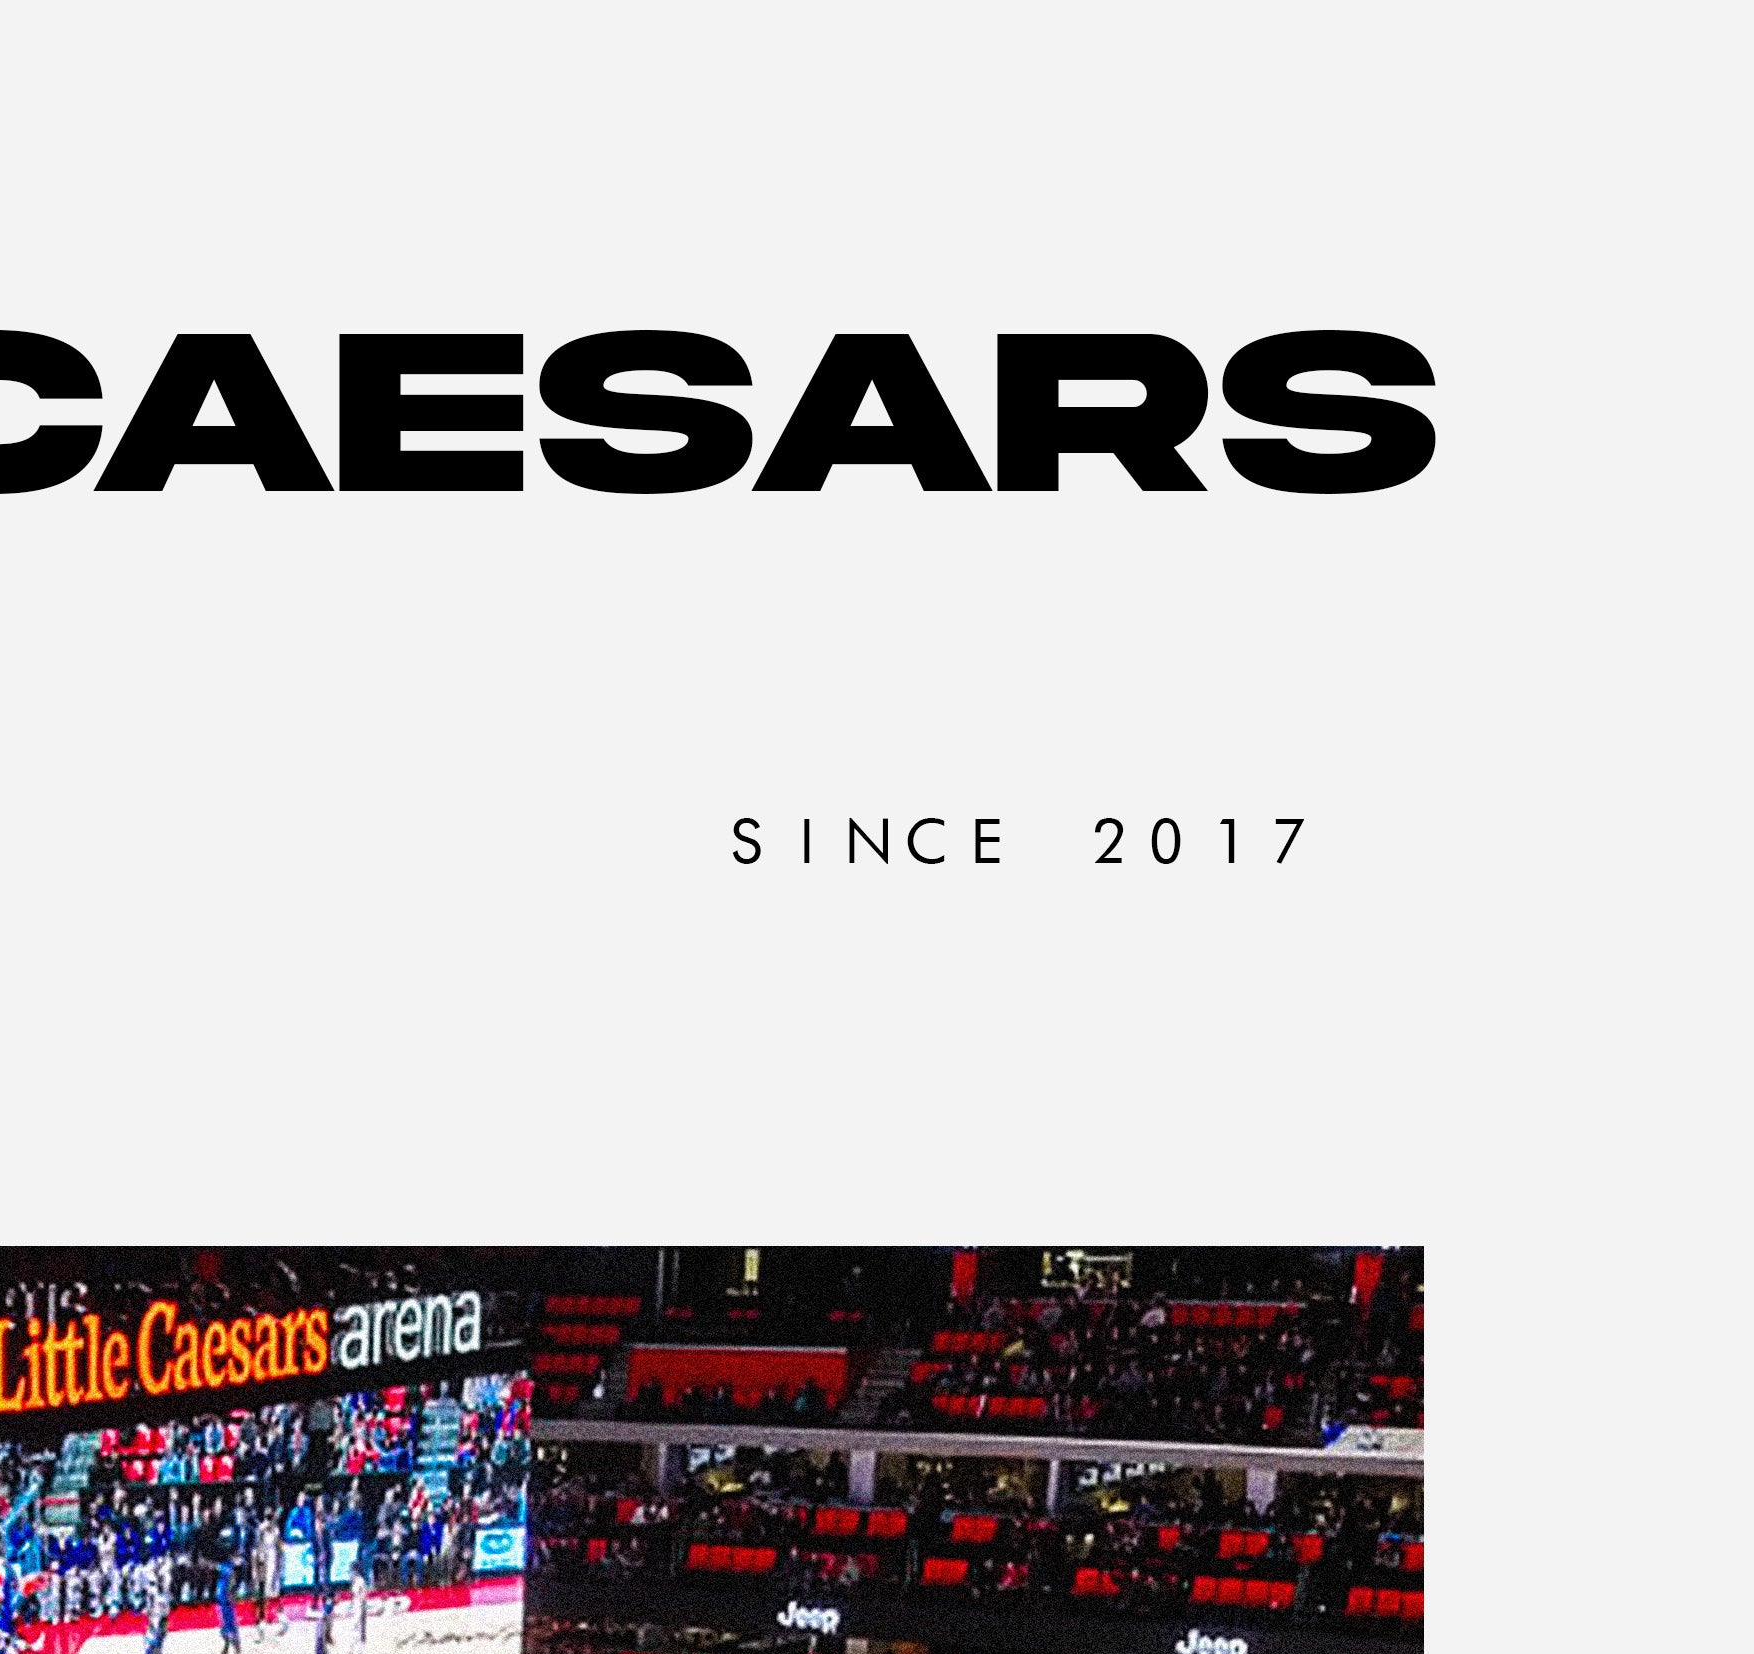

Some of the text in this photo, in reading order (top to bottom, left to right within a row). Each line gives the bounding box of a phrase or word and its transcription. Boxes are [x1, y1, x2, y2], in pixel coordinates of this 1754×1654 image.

[733, 818, 1304, 864] SINCE 2017
[138, 1301, 329, 1396] Caesars
[337, 1291, 483, 1369] arena
